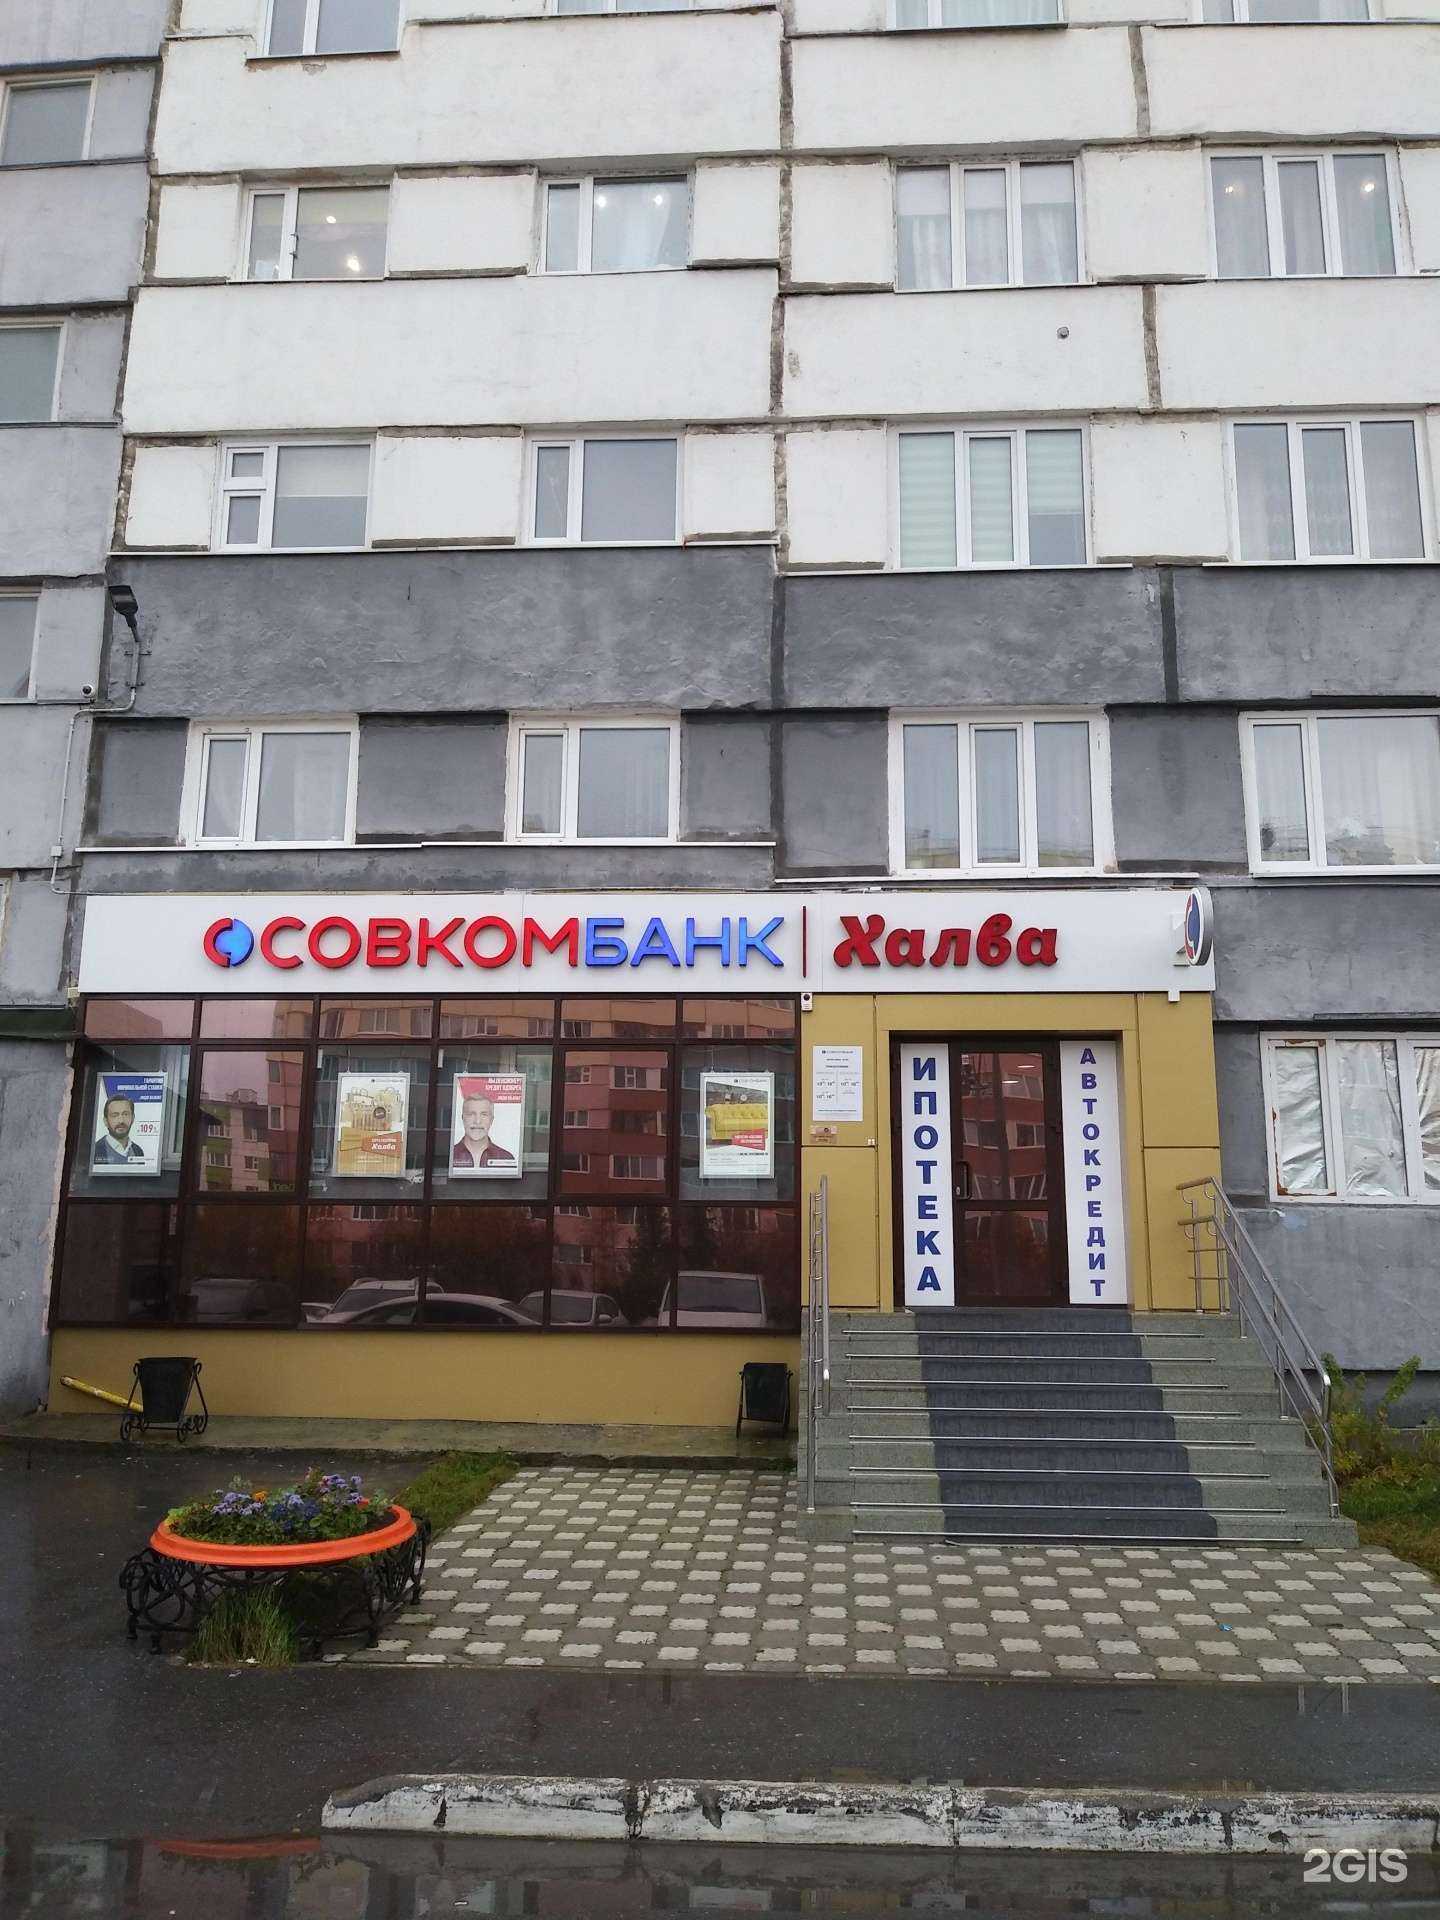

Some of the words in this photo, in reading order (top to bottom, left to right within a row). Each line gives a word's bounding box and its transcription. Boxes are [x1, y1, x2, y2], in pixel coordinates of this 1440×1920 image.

[259, 914, 785, 969] СОВКОМБАНК
[833, 913, 1059, 968] Халва
[912, 1057, 942, 1292] ИПОТЕКА
[1080, 1048, 1106, 1297] АВТОКРЕДИТ
